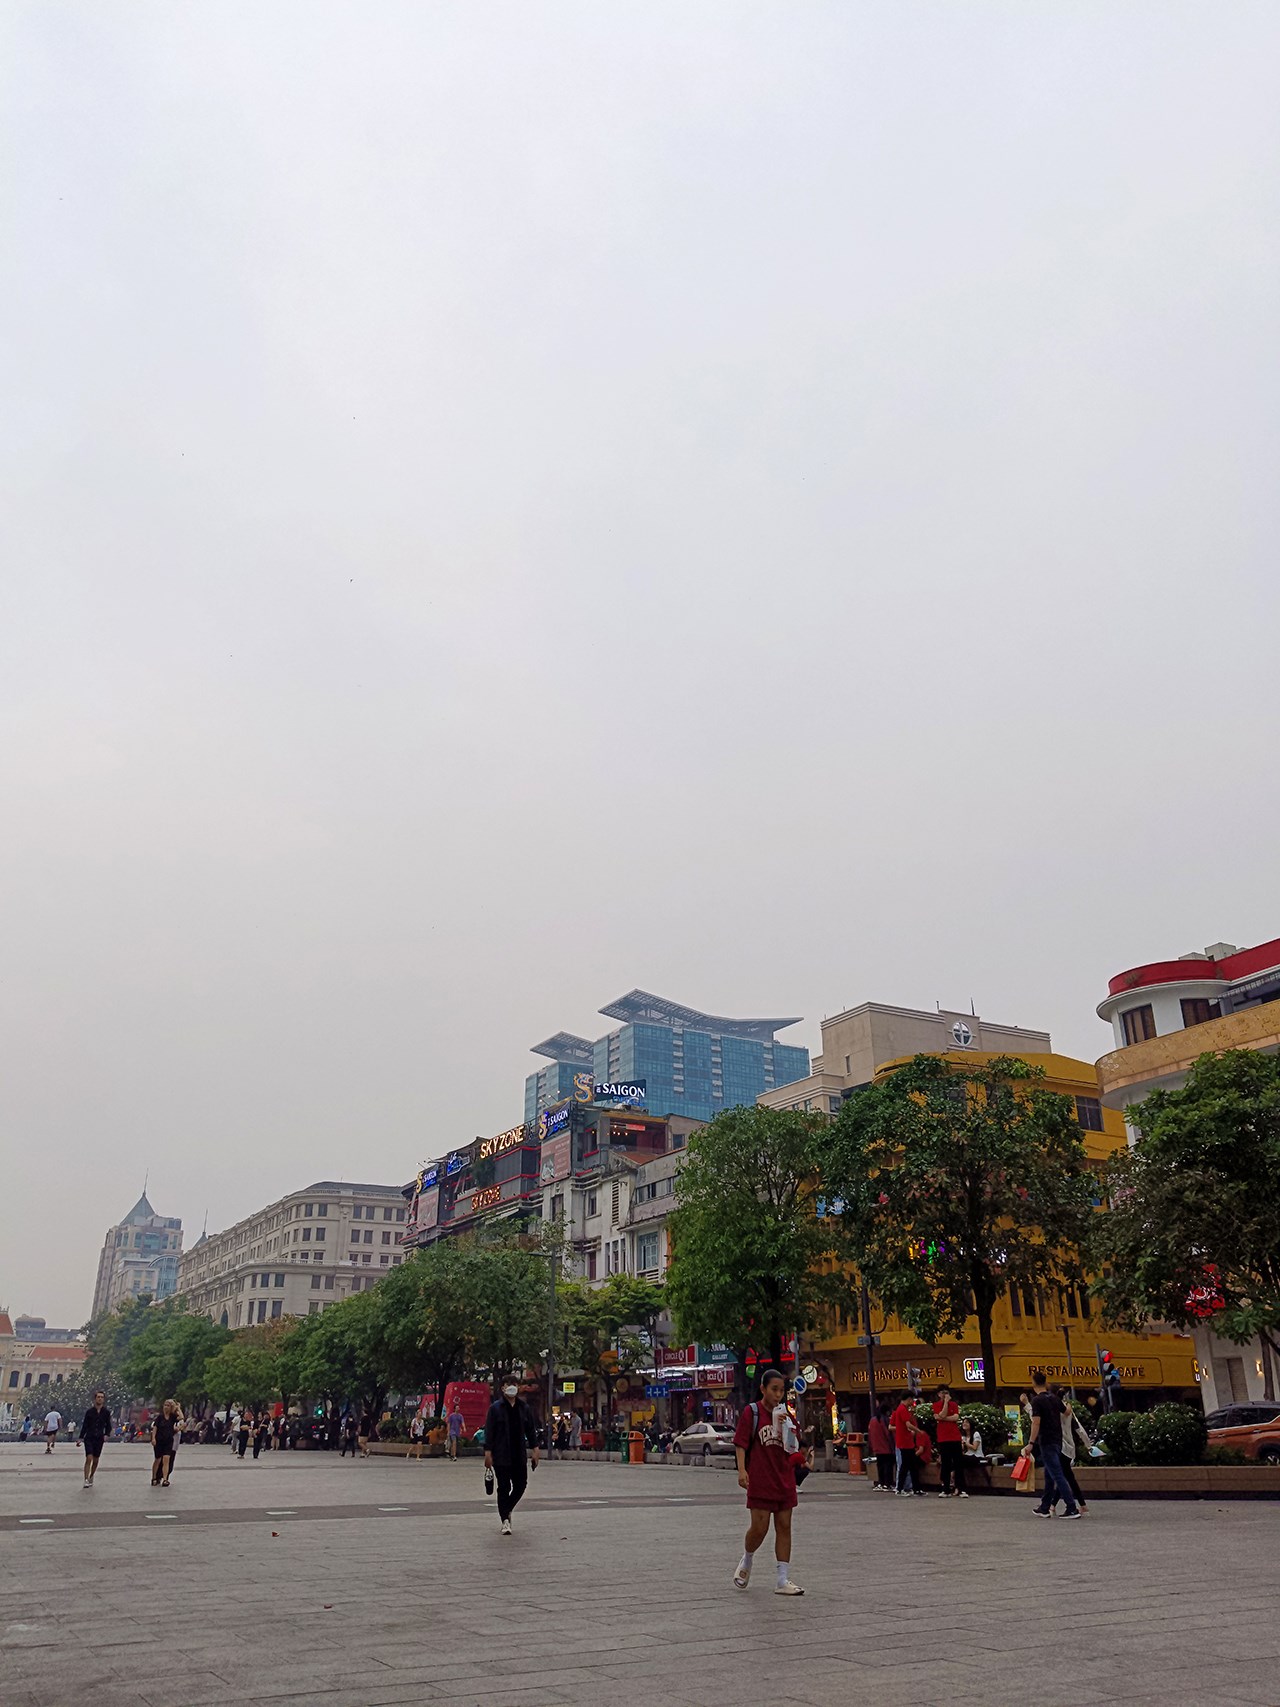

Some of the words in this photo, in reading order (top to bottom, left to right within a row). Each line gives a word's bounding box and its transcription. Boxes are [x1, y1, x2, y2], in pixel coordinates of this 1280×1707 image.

[602, 1083, 645, 1098] SAIGON
[966, 1361, 984, 1371] CIAO
[1028, 1366, 1099, 1376] RESTAURAN
[852, 1371, 869, 1382] NH
[967, 1370, 985, 1380] CAFE
